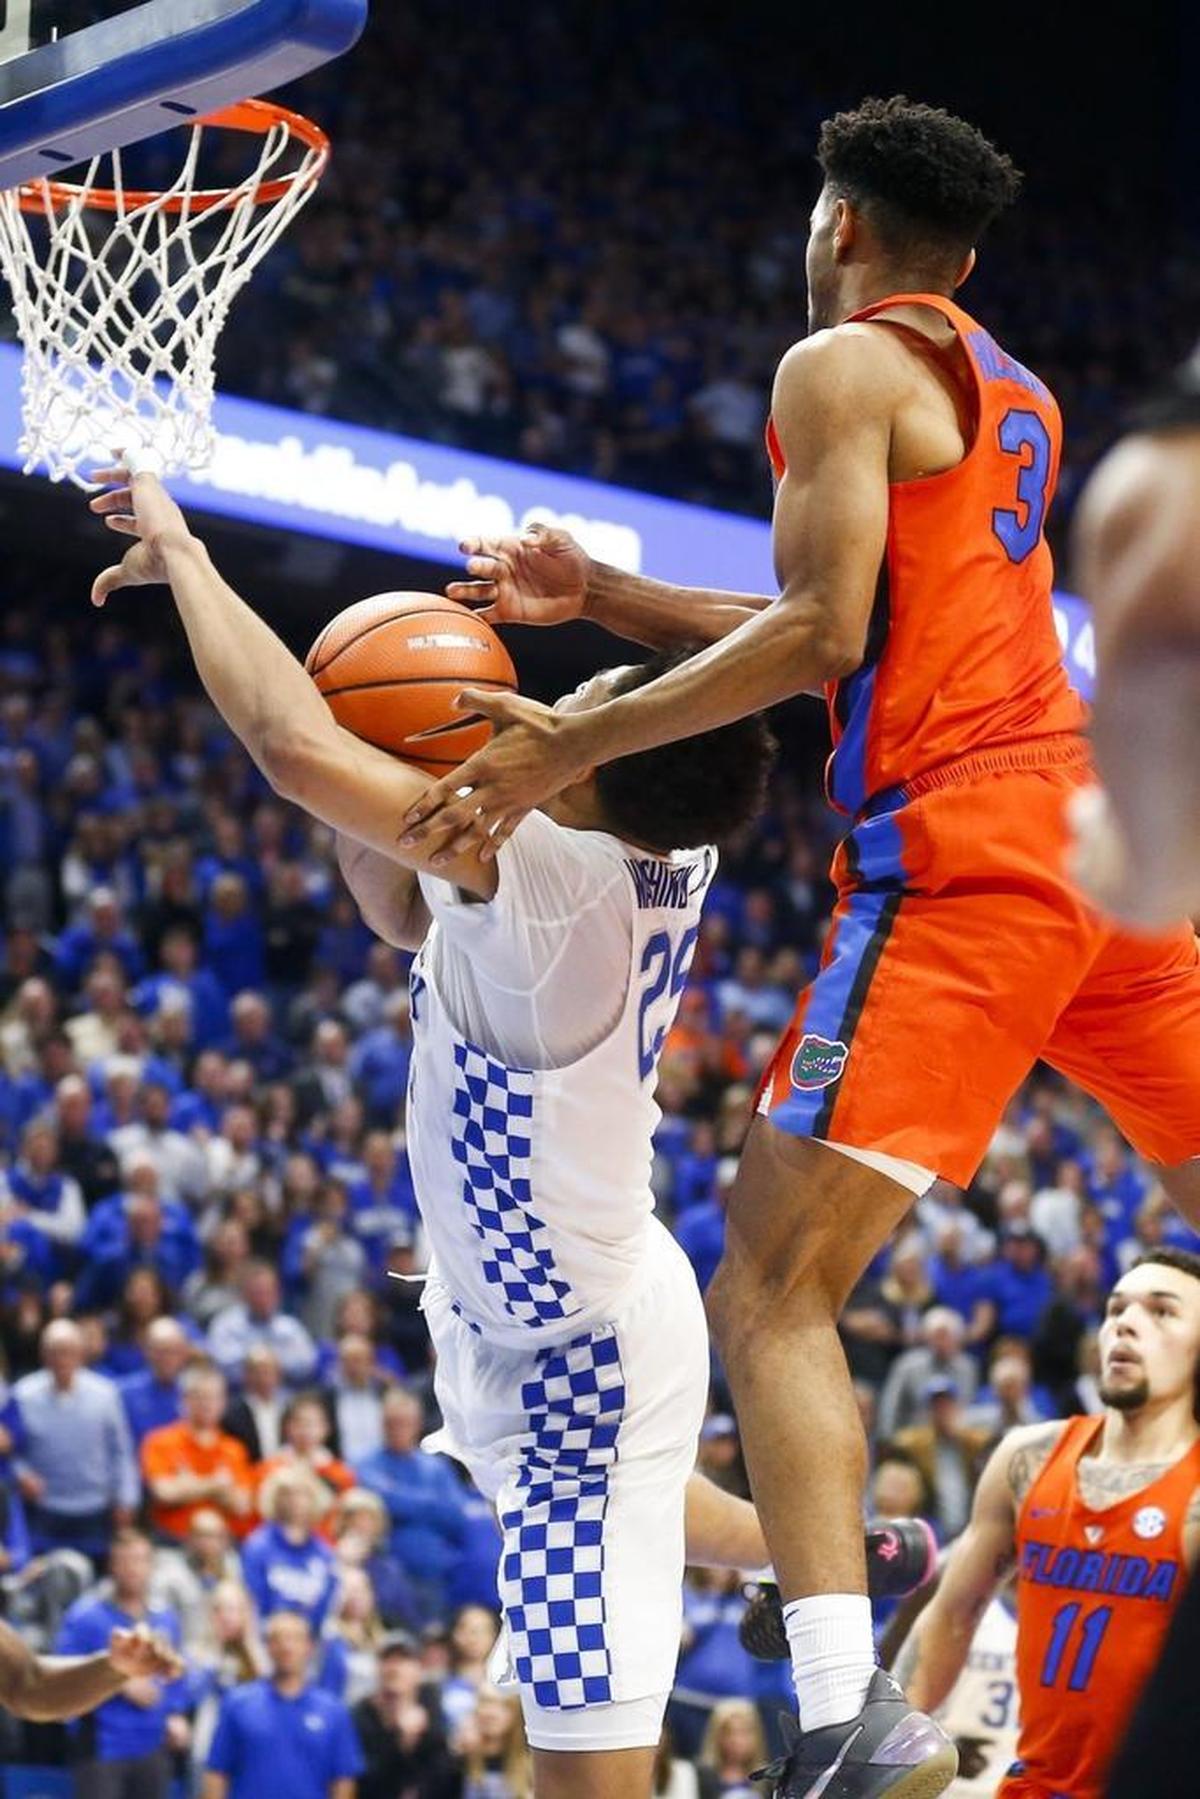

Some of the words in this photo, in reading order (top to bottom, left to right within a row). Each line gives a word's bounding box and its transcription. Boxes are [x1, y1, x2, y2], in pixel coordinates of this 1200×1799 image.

[992, 408, 1051, 565] 3
[1023, 1540, 1178, 1602] FLORIDA
[1040, 1601, 1113, 1692] 11
